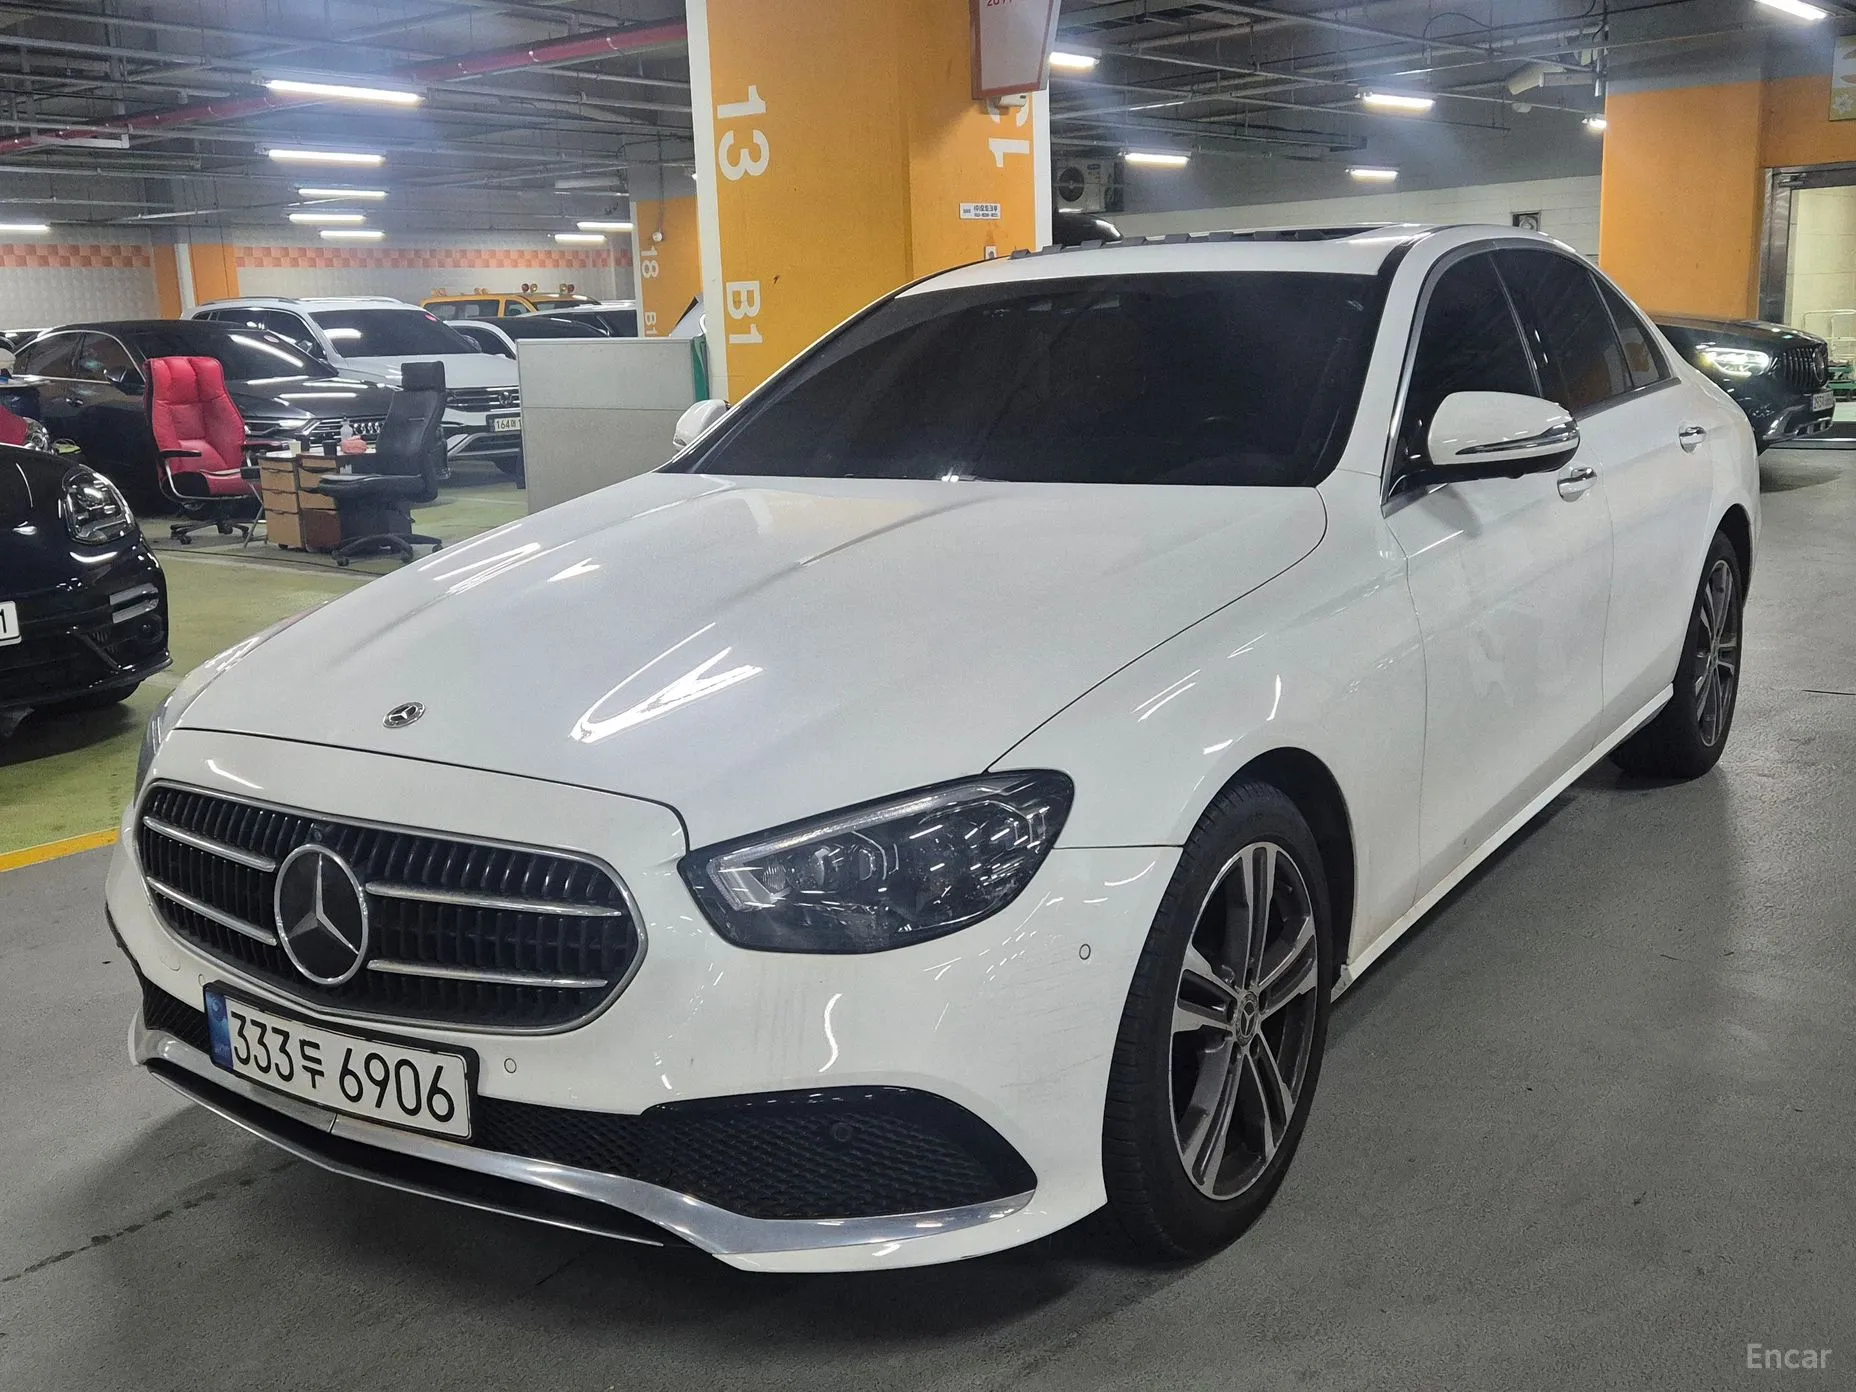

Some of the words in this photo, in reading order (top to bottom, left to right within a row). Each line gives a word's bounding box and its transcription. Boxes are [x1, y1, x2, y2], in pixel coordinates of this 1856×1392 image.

[717, 85, 770, 181] 13
[641, 245, 660, 279] 18
[645, 311, 658, 335] B1
[726, 280, 763, 344] B1
[230, 1010, 325, 1089] 333두
[339, 1048, 455, 1123] 6906
